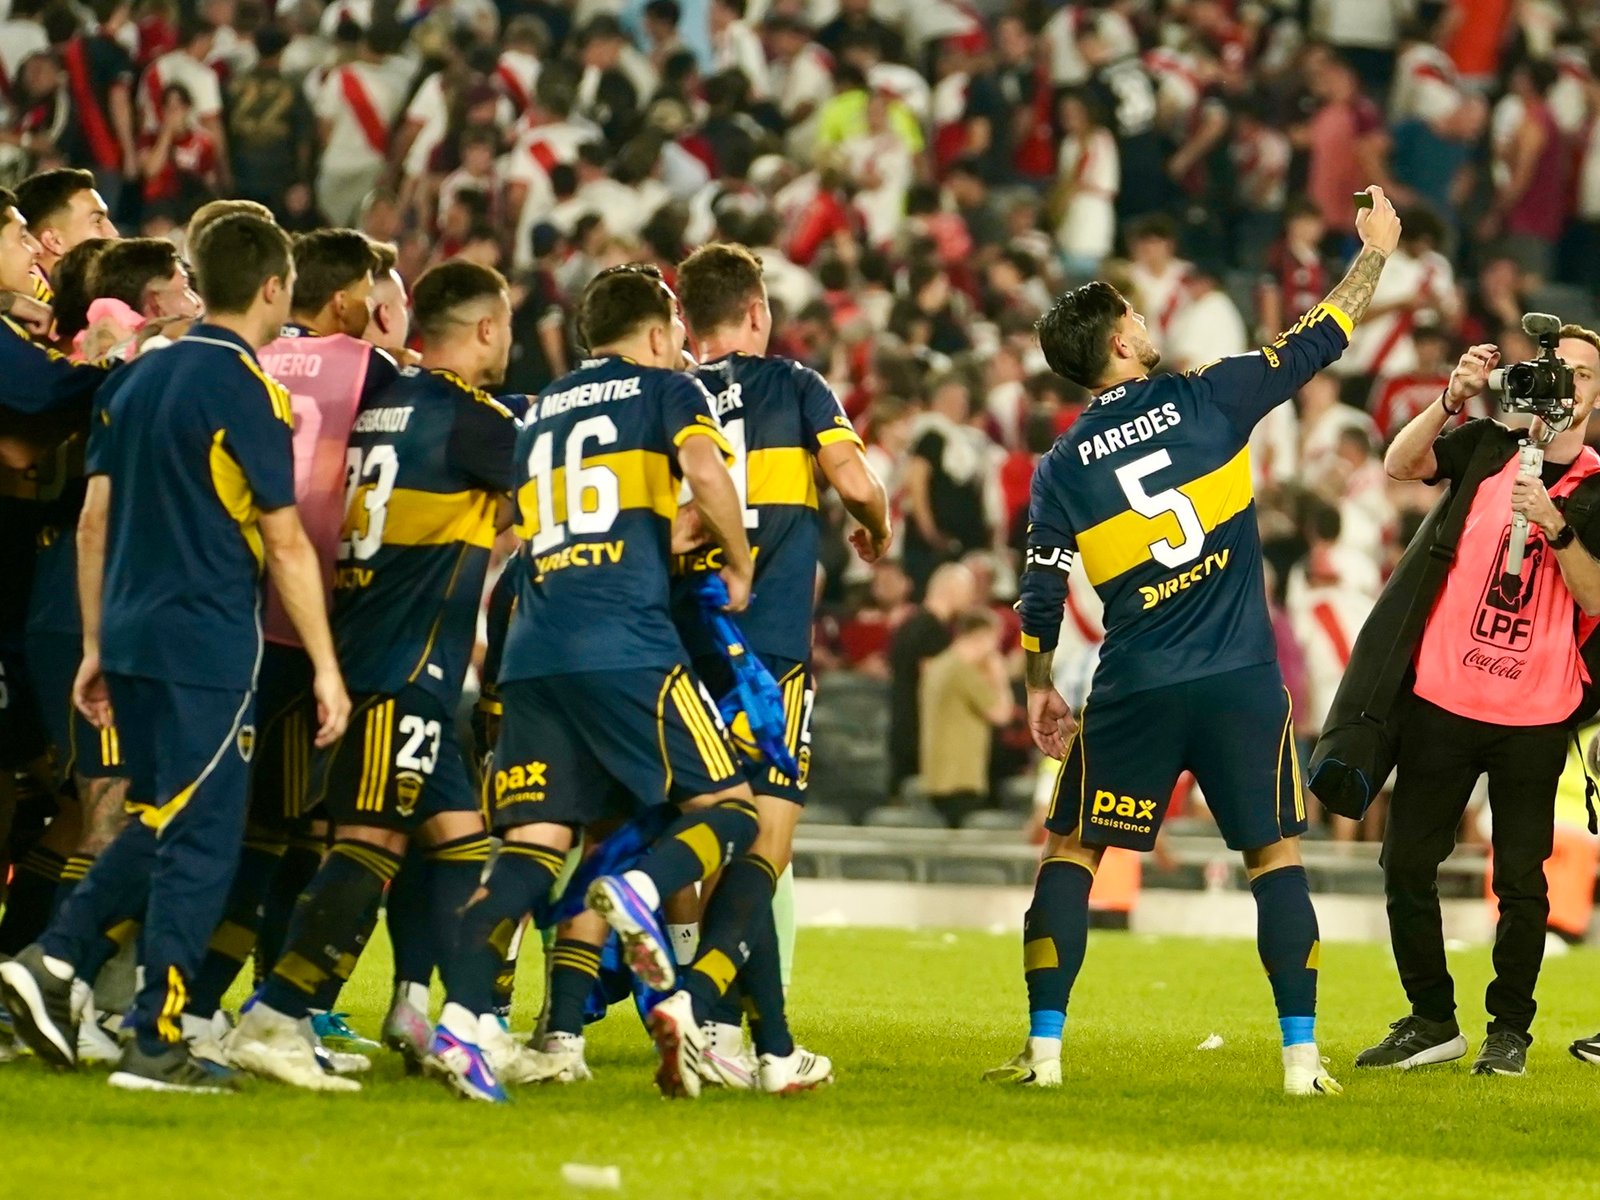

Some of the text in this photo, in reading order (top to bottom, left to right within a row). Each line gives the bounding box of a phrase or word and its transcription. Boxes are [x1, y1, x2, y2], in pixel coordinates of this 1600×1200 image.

[540, 376, 642, 421] MERENTIEL
[1077, 402, 1182, 466] PAREDES
[527, 414, 619, 557] 16
[1114, 448, 1206, 570] 5
[1138, 548, 1230, 610] DIRECTV
[1475, 608, 1532, 645] LPF
[395, 714, 442, 775] 23
[494, 760, 548, 803] pax
[1091, 789, 1157, 820] pax
[1090, 815, 1151, 833] assistance
